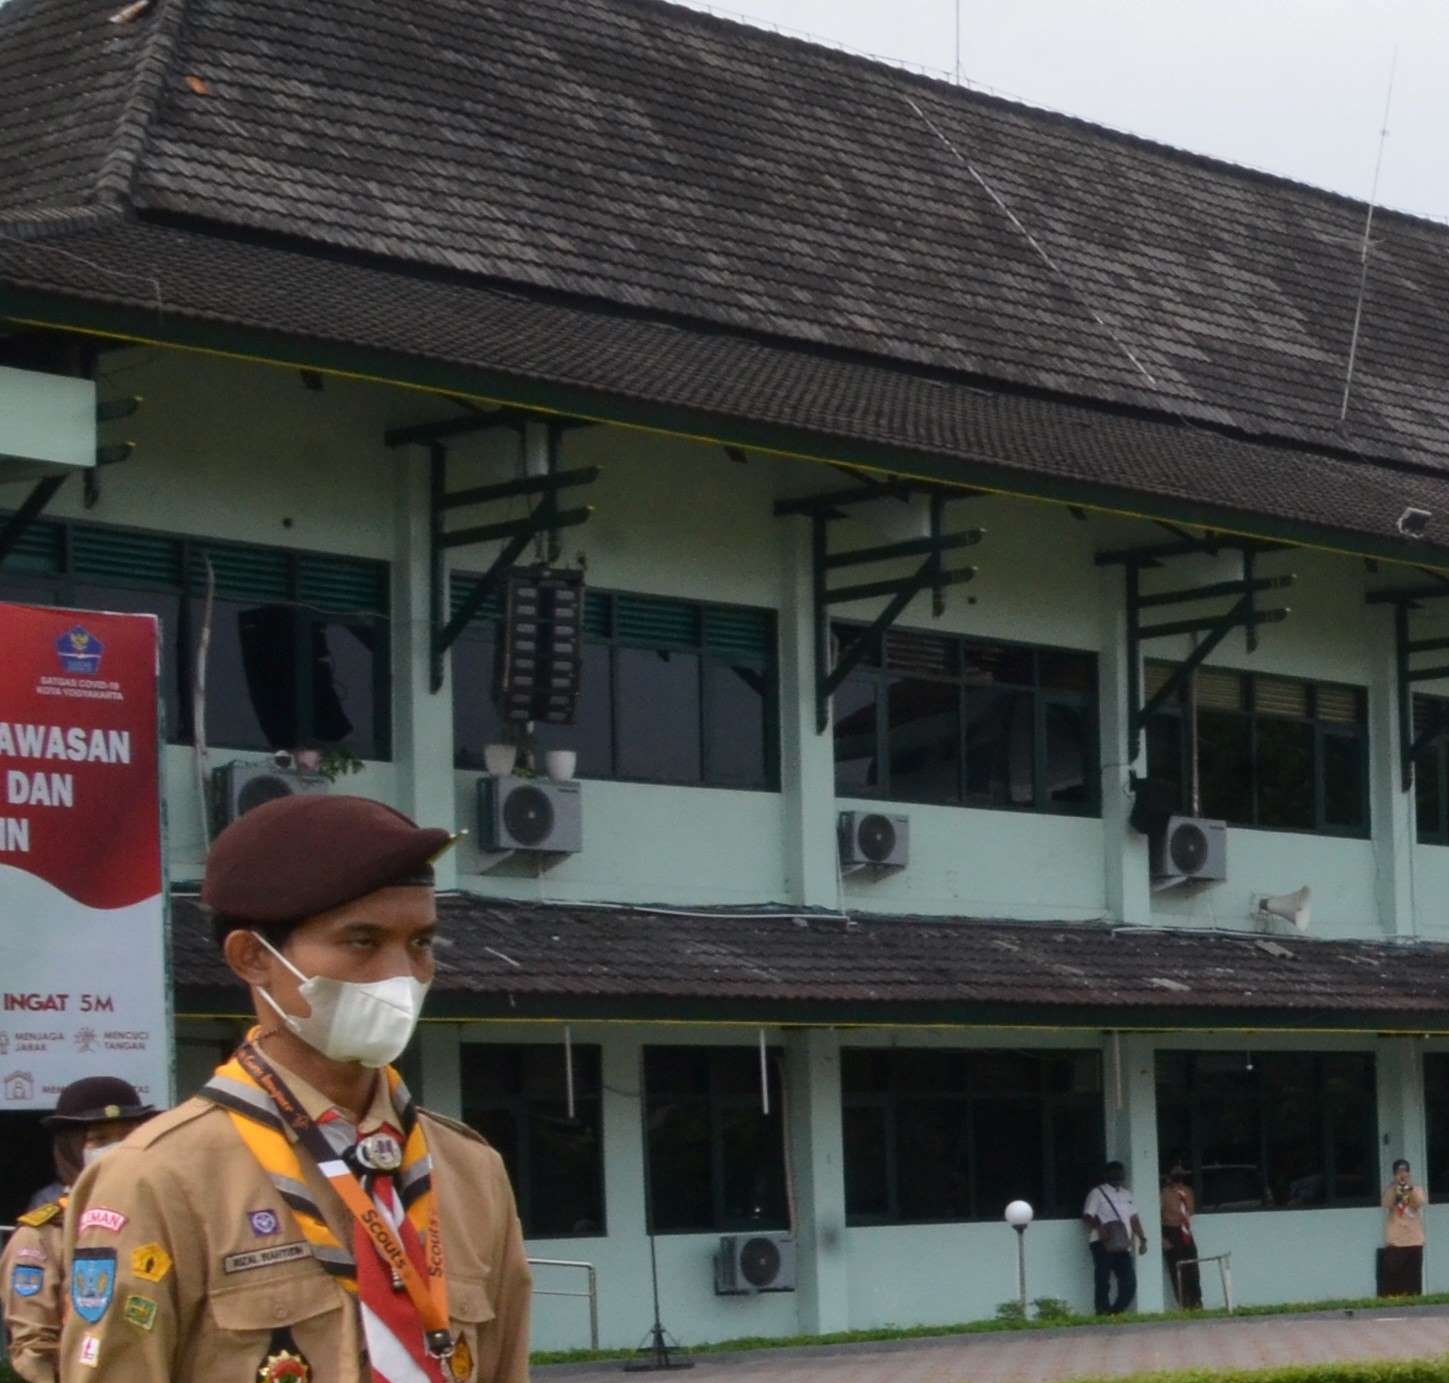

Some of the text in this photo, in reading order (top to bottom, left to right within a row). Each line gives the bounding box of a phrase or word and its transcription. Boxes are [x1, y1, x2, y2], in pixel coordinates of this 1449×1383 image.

[0, 722, 131, 764] AWASAN
[7, 769, 74, 808] DAN
[4, 993, 115, 1012] INGAT 5M
[361, 1209, 407, 1270] Scouts
[427, 1218, 443, 1278] Scouts
